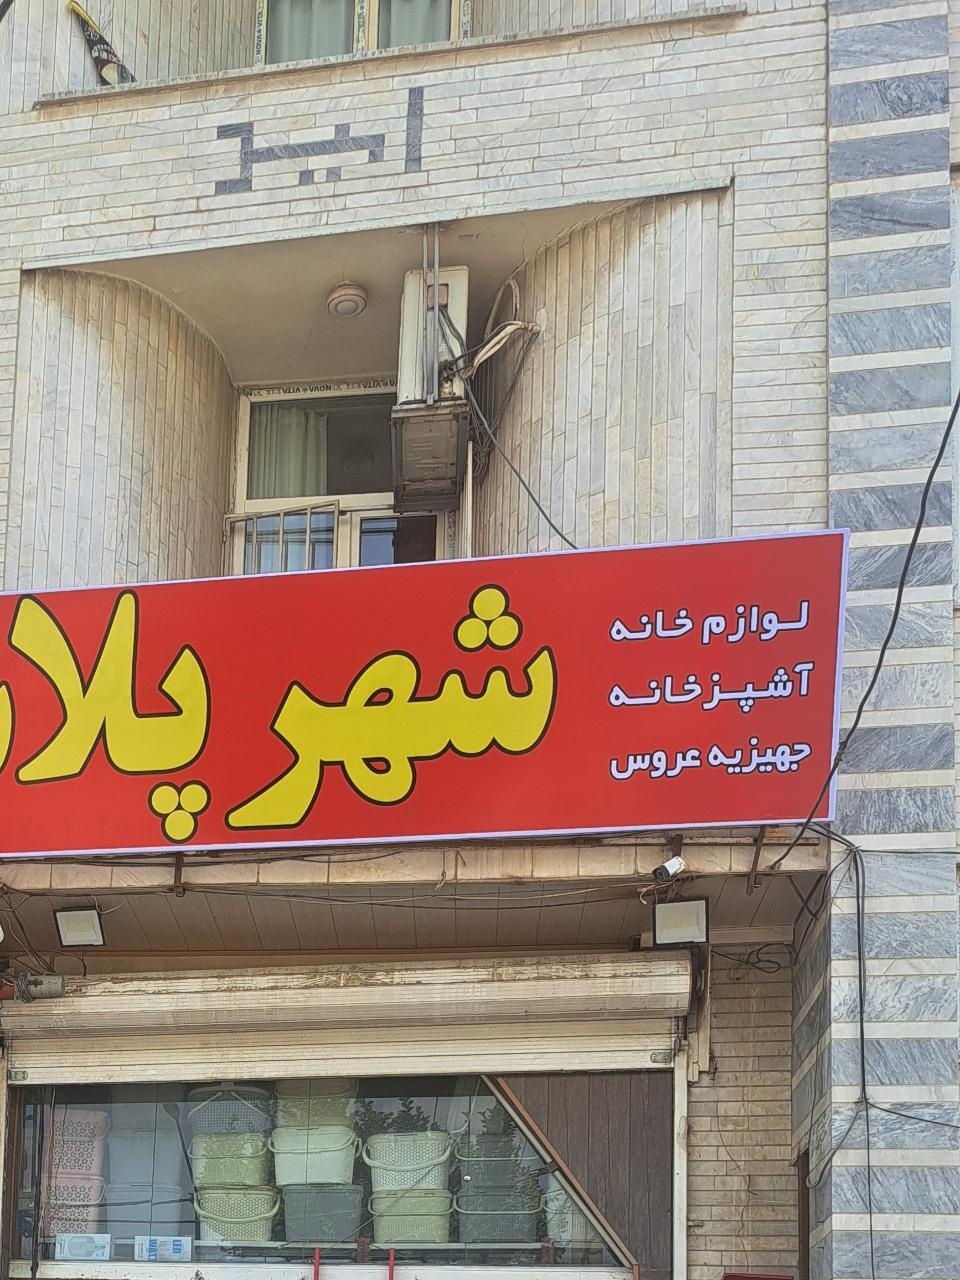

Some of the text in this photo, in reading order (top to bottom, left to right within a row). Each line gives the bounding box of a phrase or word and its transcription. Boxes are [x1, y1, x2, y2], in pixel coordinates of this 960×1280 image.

[282, 384, 332, 394] NOVA VITA
[610, 601, 809, 644] لوازم خانه
[227, 585, 558, 832] شهر
[609, 662, 814, 713] آشپزخانه
[610, 737, 812, 780] جهیزیه عروس
